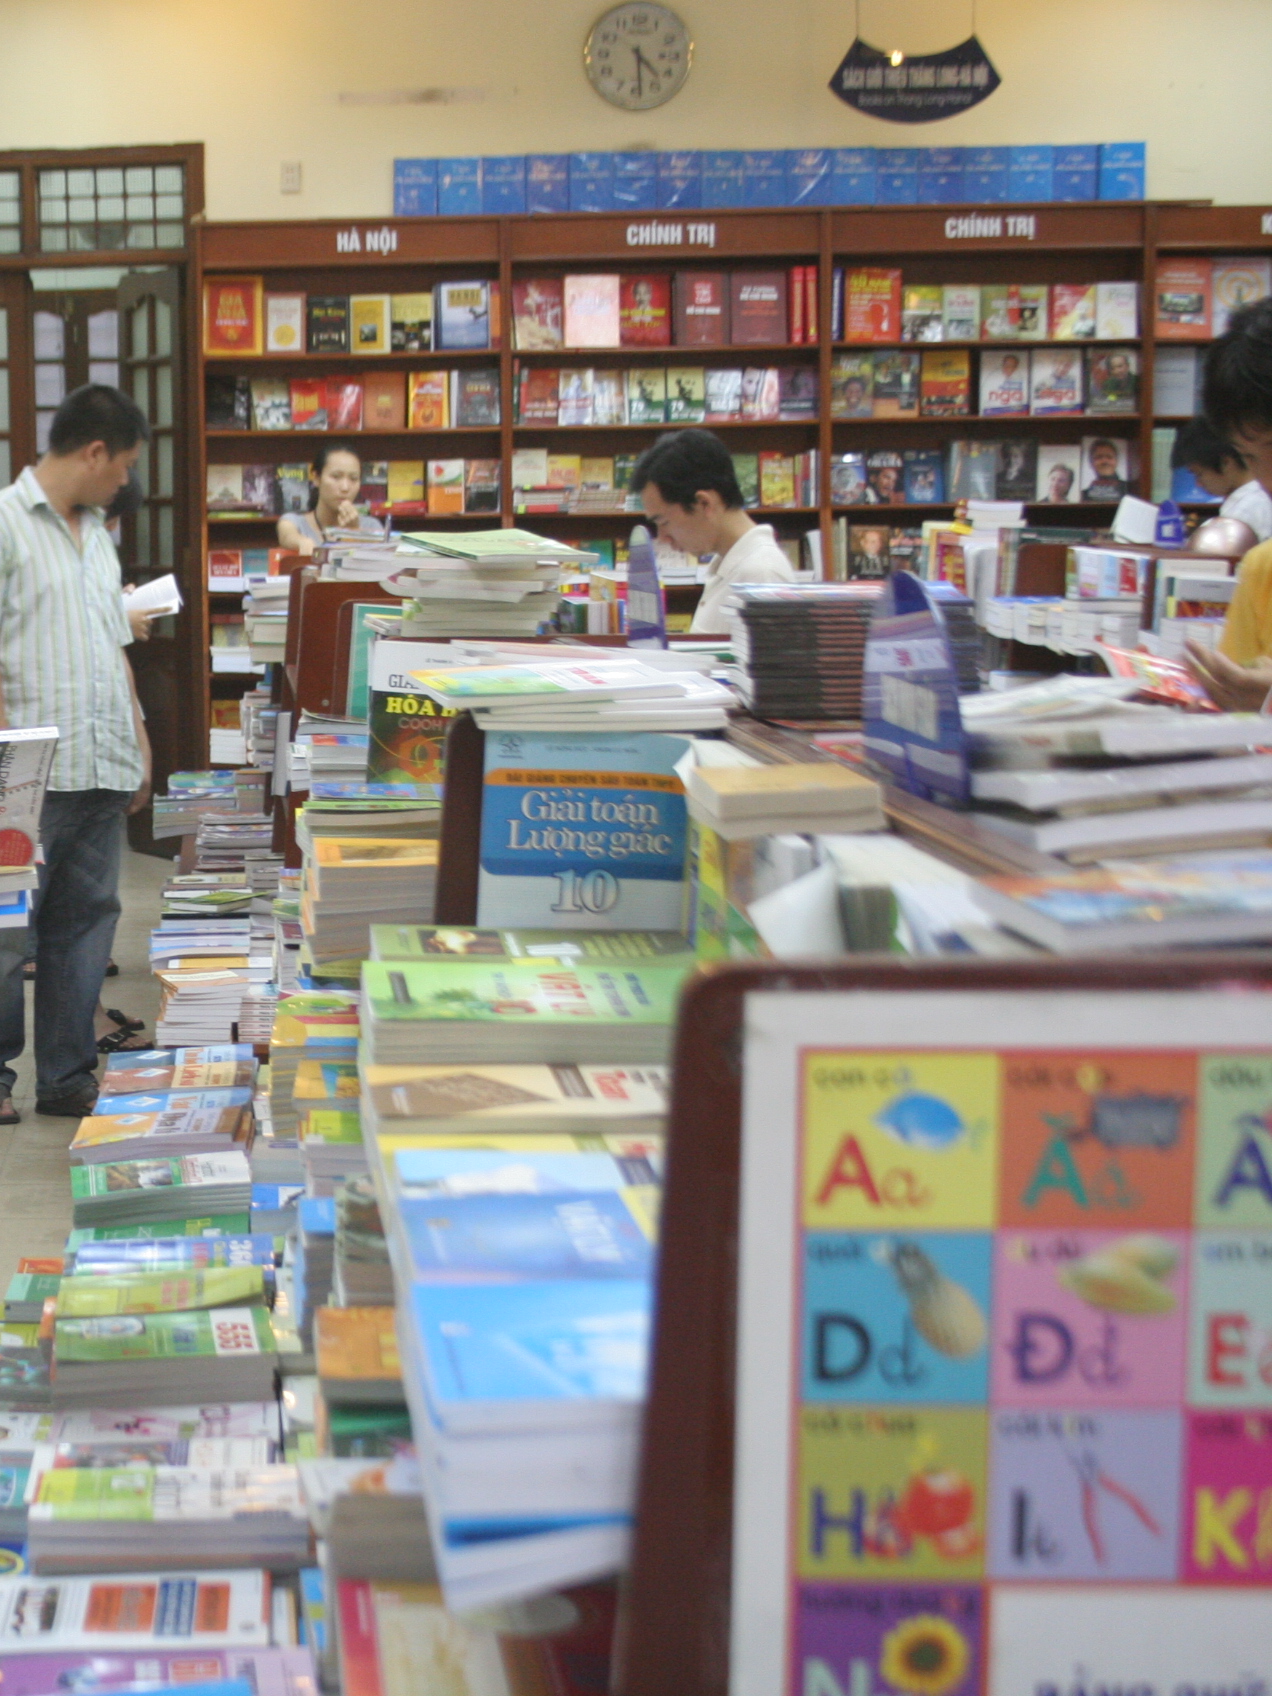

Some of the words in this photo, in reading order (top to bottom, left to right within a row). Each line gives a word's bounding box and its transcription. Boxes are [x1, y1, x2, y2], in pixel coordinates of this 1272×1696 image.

[337, 227, 362, 253] HÀ
[367, 225, 397, 256] NỘI
[627, 221, 682, 246] CHÍNH
[687, 223, 716, 248] TRỊ
[945, 213, 1001, 238] CHÍNH
[1006, 215, 1036, 240] TRỊ
[520, 788, 587, 823] Giải
[589, 793, 661, 825] toán
[506, 819, 606, 860] Lượng
[608, 824, 672, 860] giác
[550, 868, 620, 916] 10
[816, 1131, 932, 1209] Aa
[811, 1310, 927, 1387] Dd
